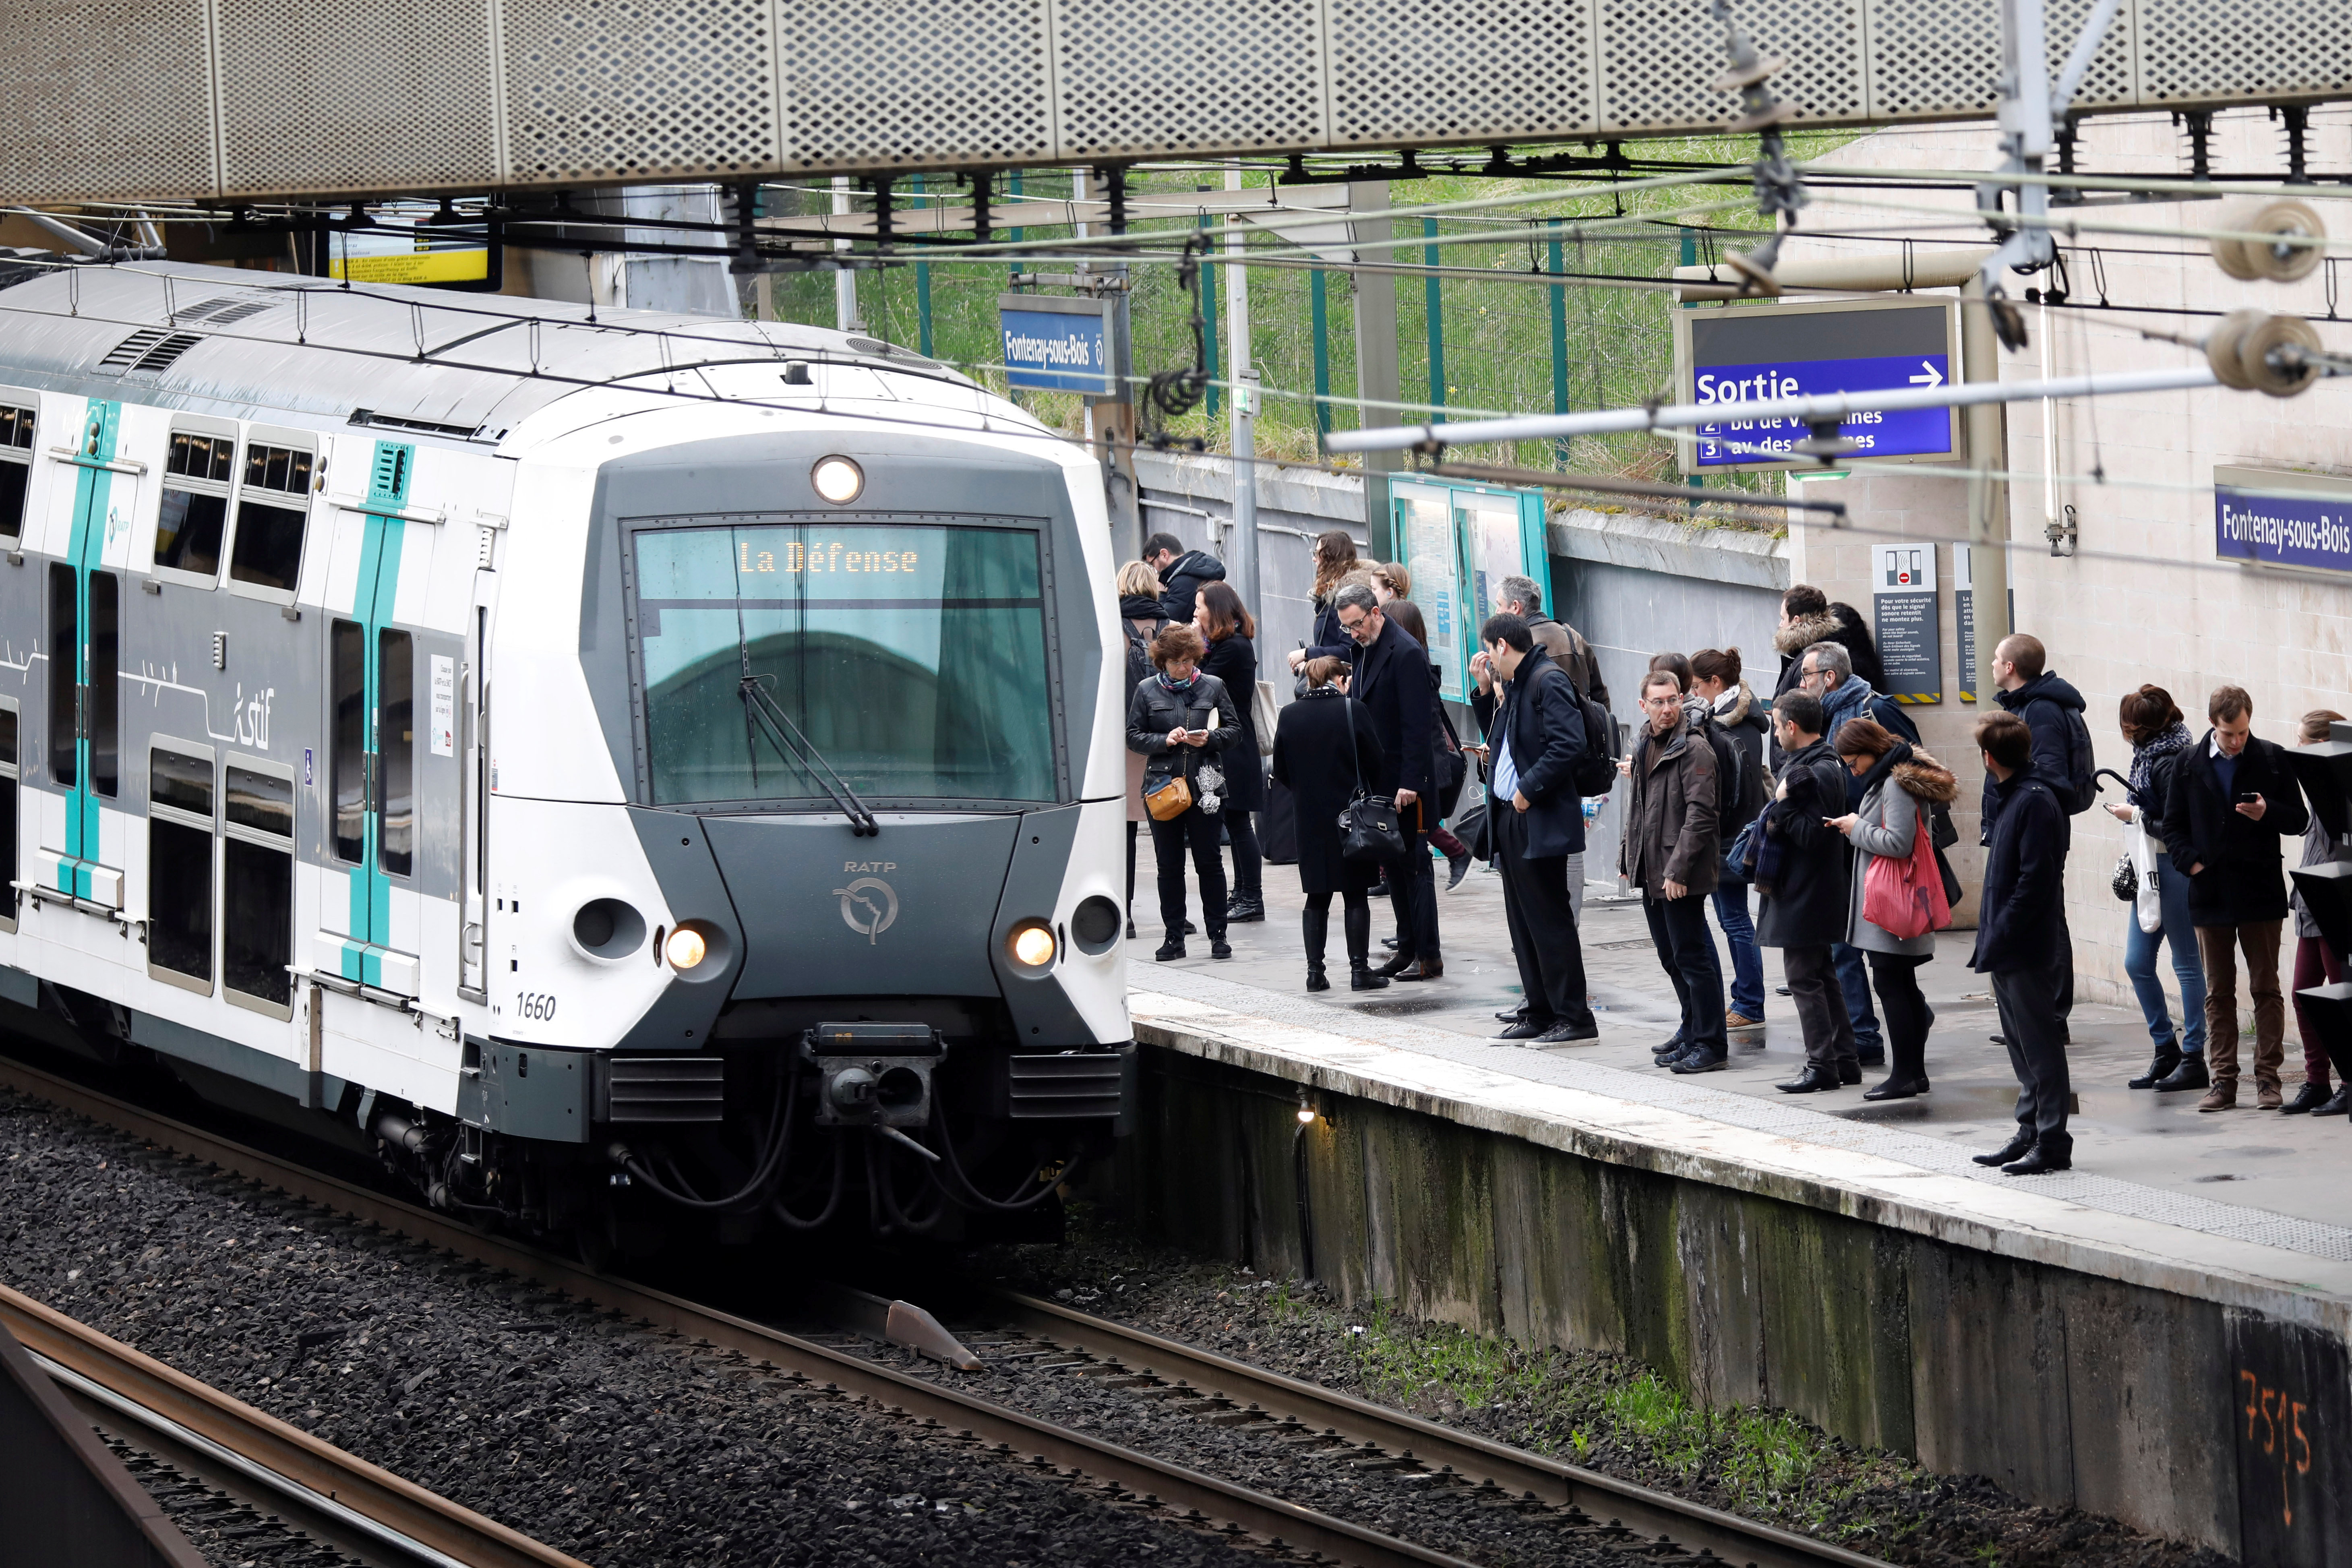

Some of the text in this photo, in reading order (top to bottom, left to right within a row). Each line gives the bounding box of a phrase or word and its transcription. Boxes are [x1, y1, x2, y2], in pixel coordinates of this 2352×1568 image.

[1005, 330, 1089, 370] Fontenay-sous-Bois
[1698, 370, 1799, 405] Sortie
[1705, 421, 1715, 432] 2
[1760, 416, 1782, 429] de
[1705, 440, 1716, 456] 3
[1731, 441, 1757, 454] av.
[1760, 436, 1792, 453] des
[117, 520, 129, 532] RATP
[2223, 504, 2350, 555] Fontenay-sous-Bois
[741, 542, 917, 572] La Défense
[241, 687, 274, 750] stif
[844, 861, 897, 873] RATP
[517, 991, 556, 1022] 1660
[2240, 1369, 2311, 1475] 7515
